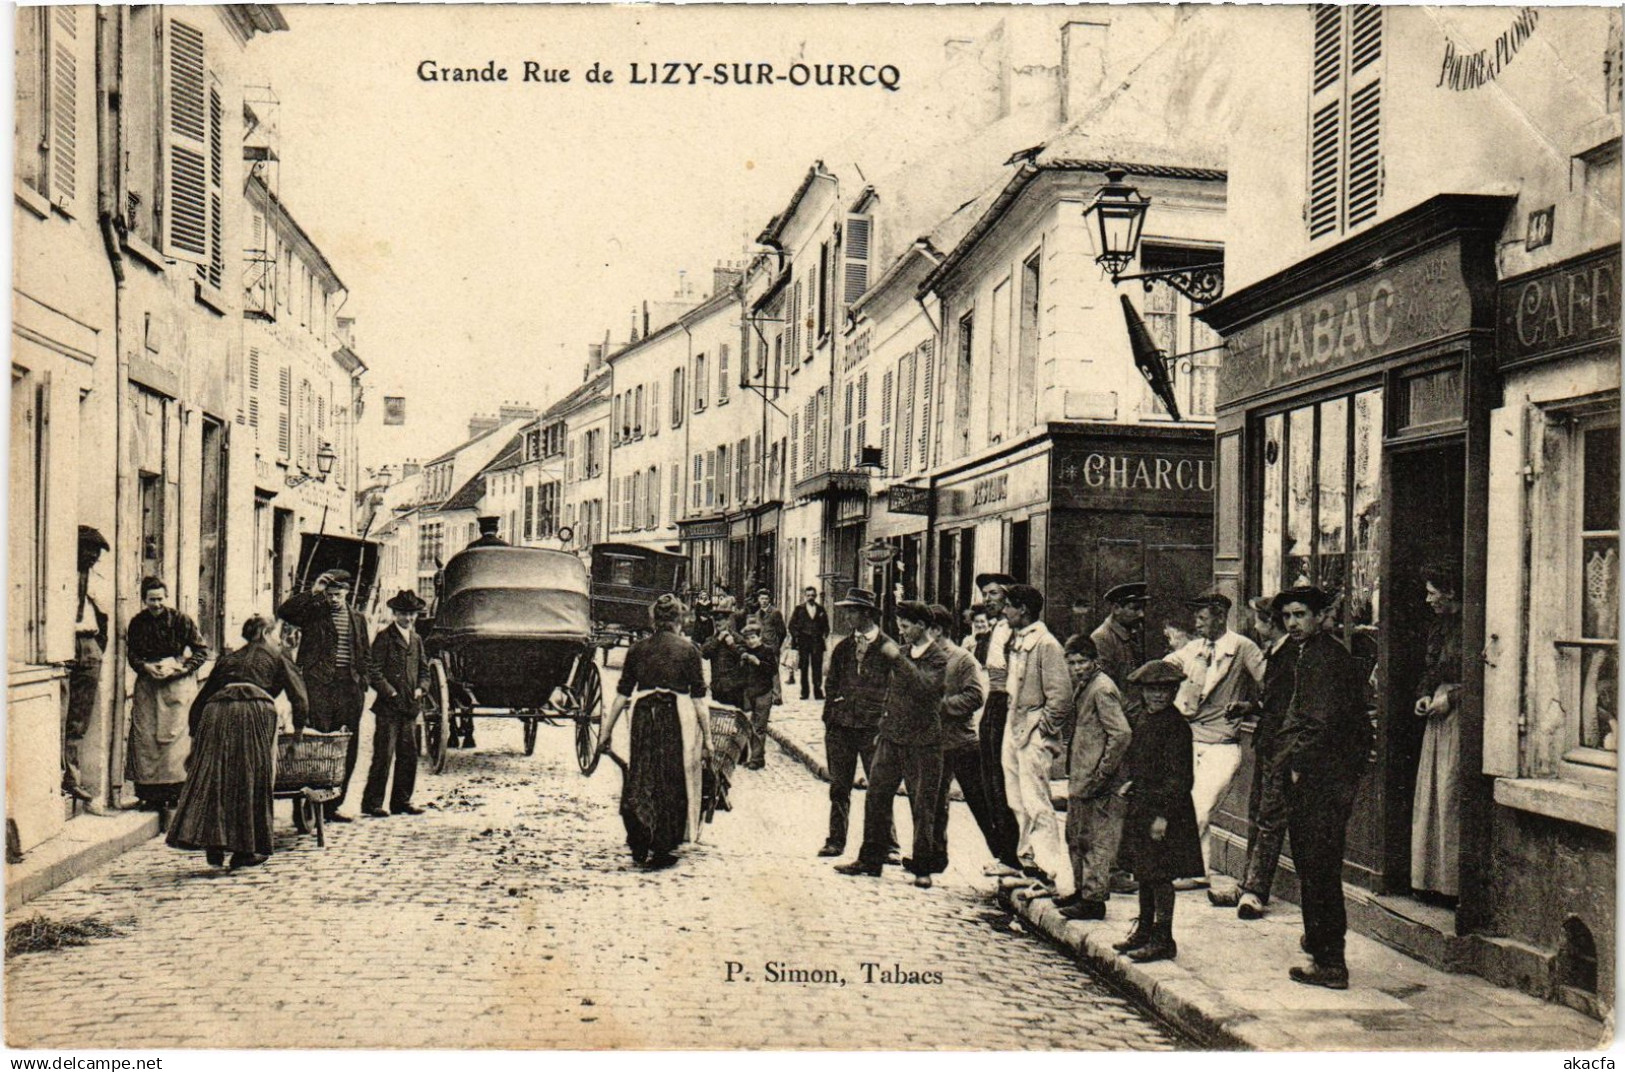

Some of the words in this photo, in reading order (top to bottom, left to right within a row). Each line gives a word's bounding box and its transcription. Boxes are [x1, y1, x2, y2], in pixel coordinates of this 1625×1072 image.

[1436, 37, 1487, 91] POUDRE
[1262, 279, 1394, 389] TABAC
[1083, 453, 1216, 492] CHARCU
